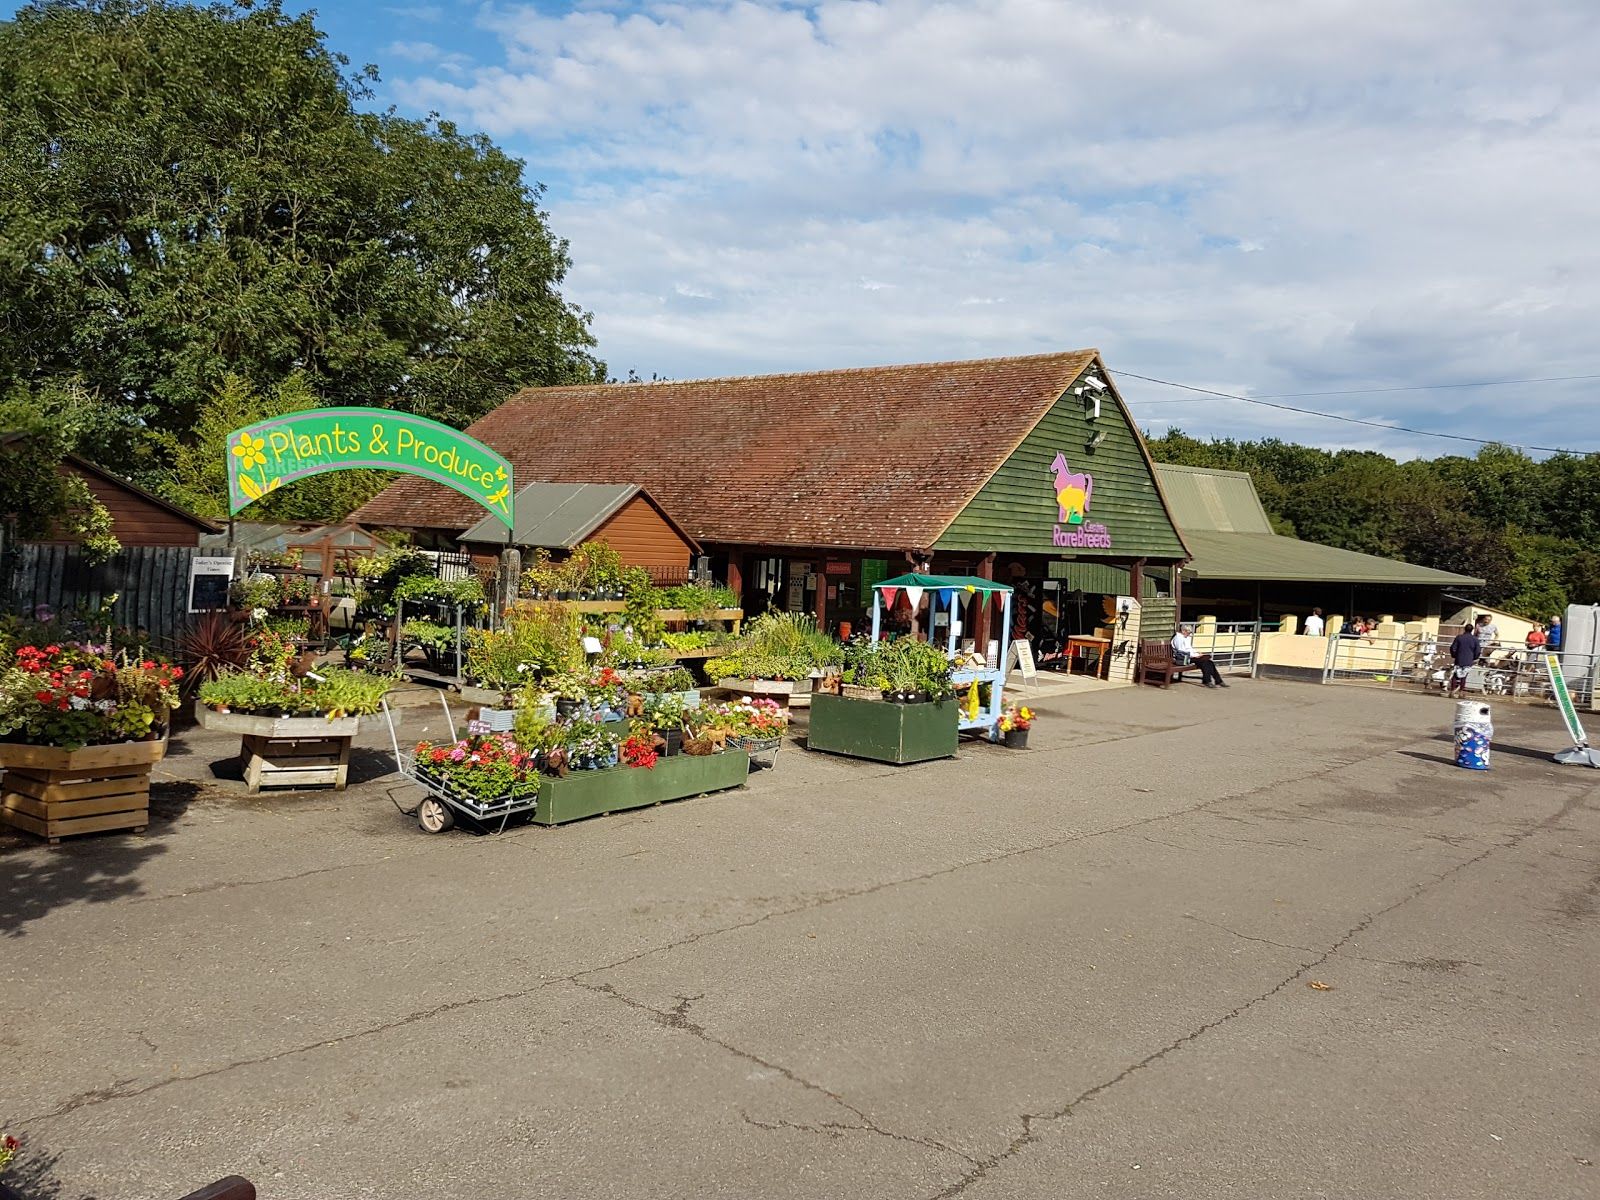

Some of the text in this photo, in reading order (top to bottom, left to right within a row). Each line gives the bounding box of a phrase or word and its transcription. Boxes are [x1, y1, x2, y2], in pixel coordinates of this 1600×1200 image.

[269, 423, 494, 489] Plants & Produce
